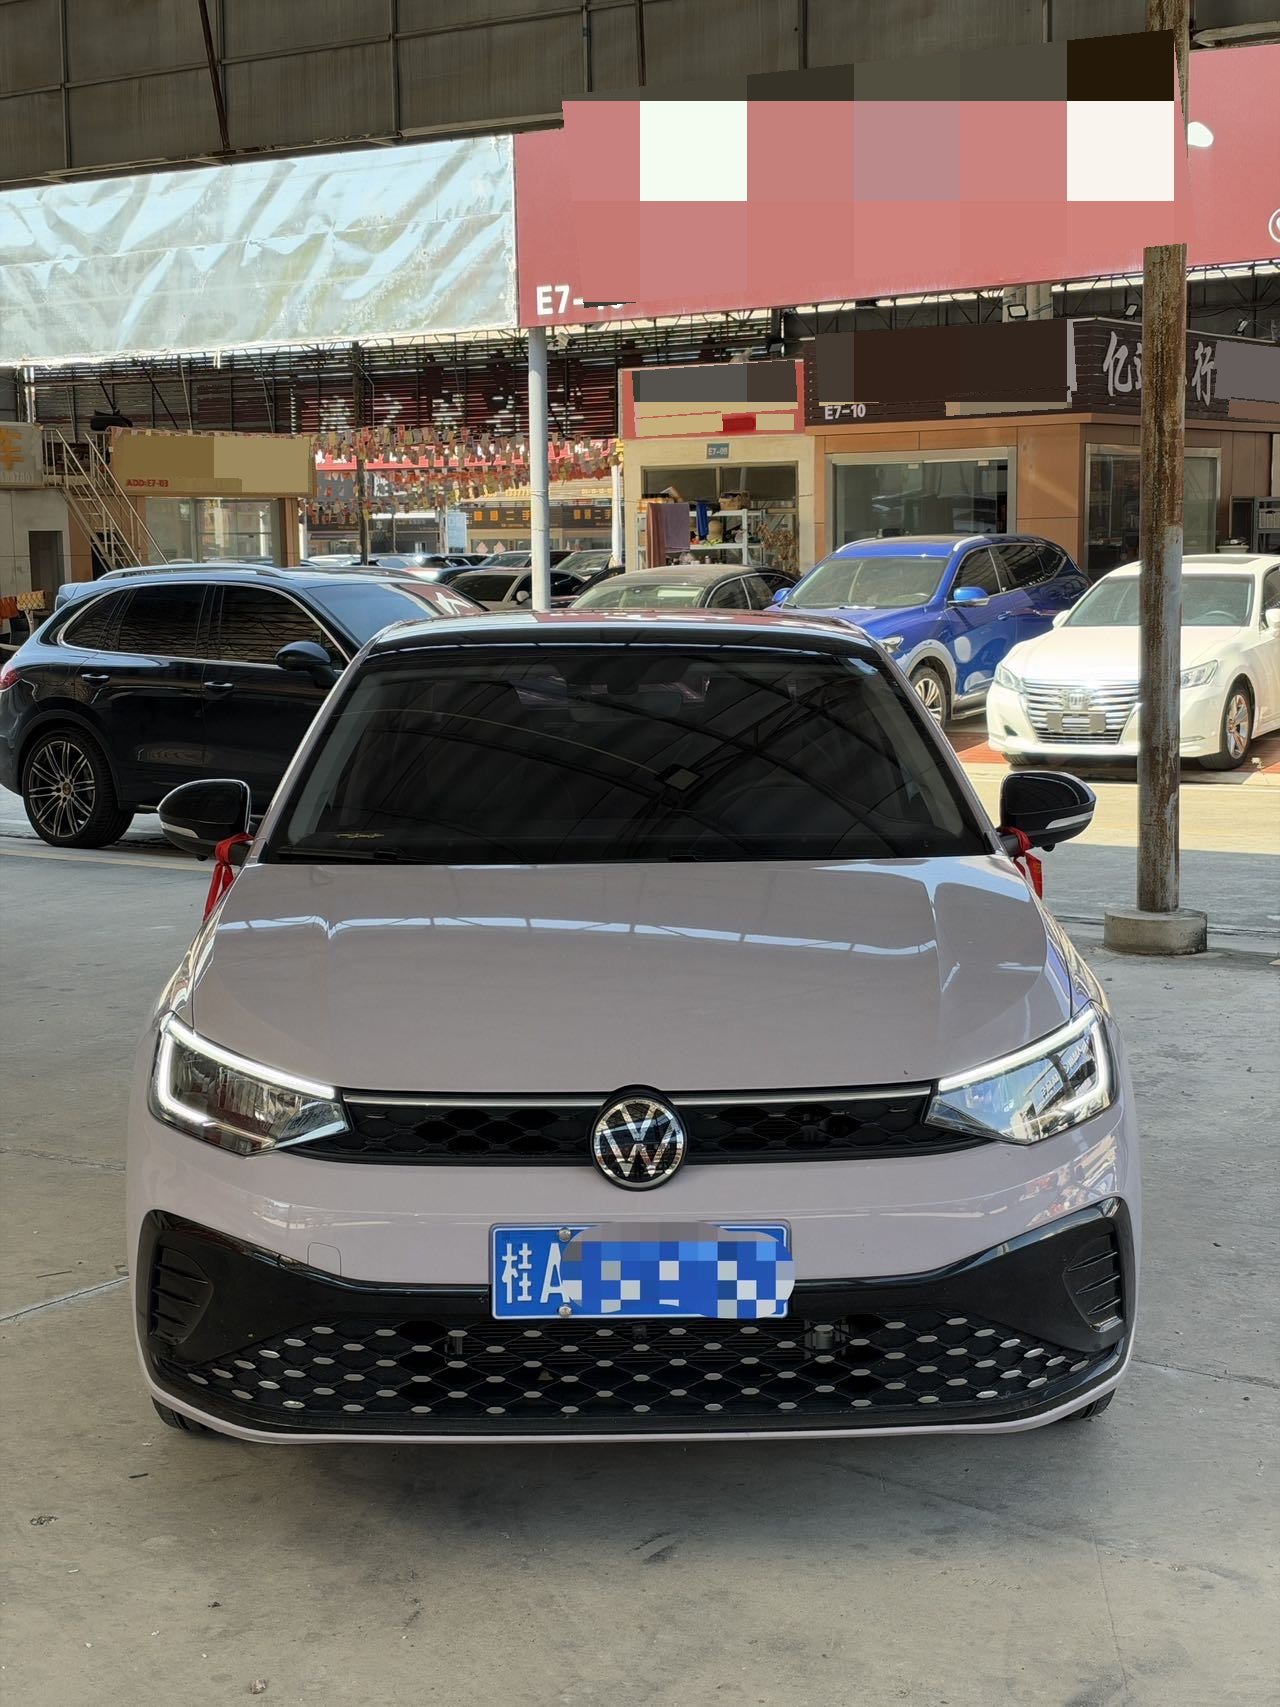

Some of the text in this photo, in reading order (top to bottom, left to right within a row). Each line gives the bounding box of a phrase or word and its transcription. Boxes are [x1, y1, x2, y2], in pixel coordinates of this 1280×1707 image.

[536, 285, 623, 315] E7-
[1103, 331, 1215, 405] 亿行
[824, 404, 866, 420] E7-10
